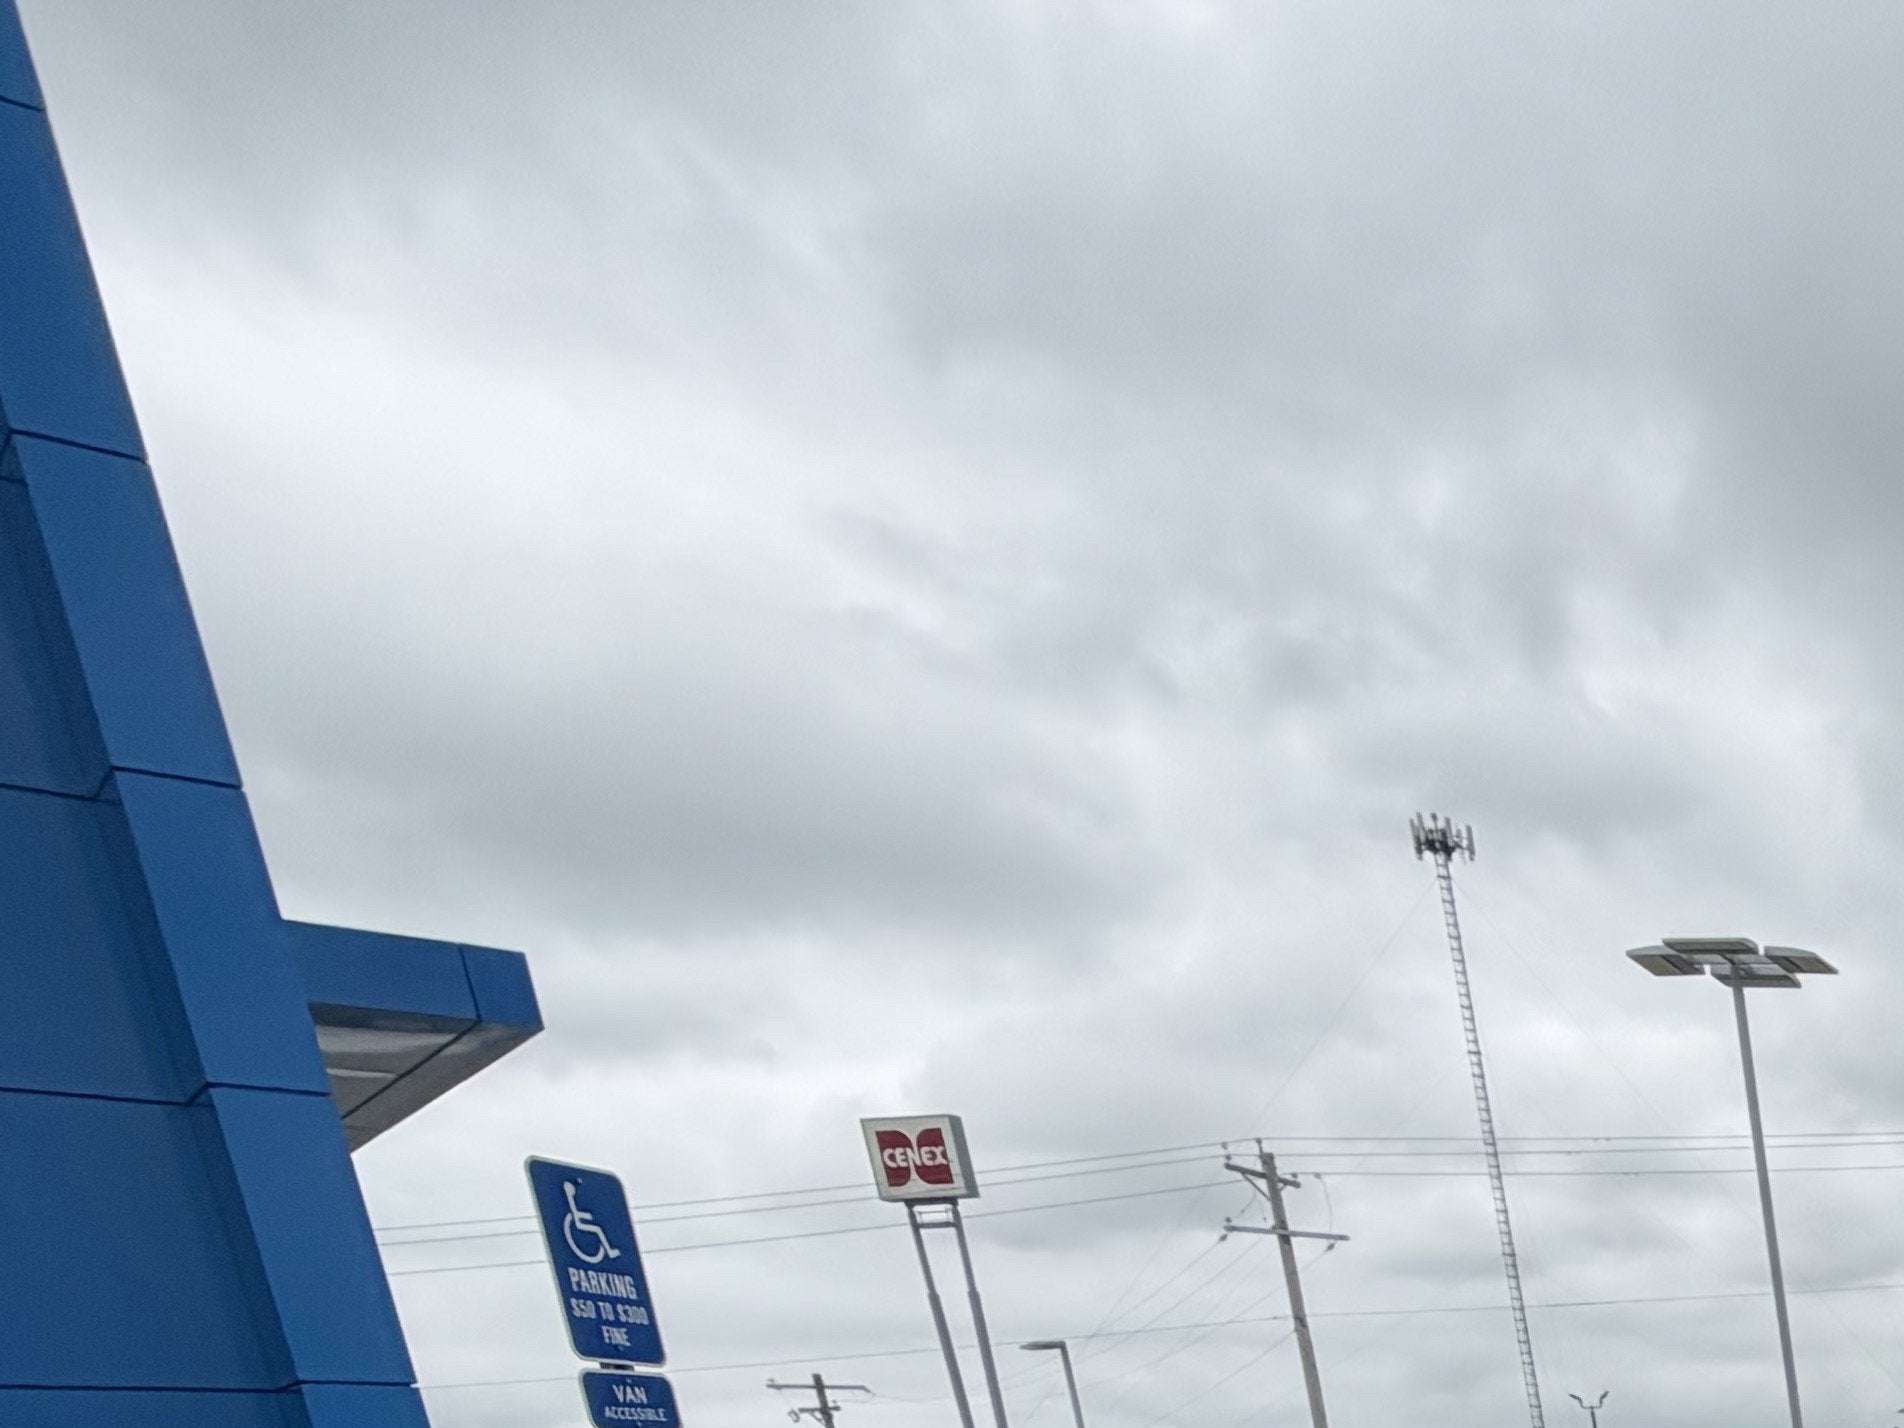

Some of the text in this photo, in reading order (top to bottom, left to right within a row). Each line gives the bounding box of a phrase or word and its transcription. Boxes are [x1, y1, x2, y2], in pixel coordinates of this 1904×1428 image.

[882, 1145, 948, 1168] CENEX
[567, 1267, 638, 1300] PARKING
[598, 1301, 616, 1321] TO
[601, 1325, 632, 1347] FINE
[612, 1384, 648, 1404] VAN
[604, 1406, 667, 1422] ACCESSIBLE
